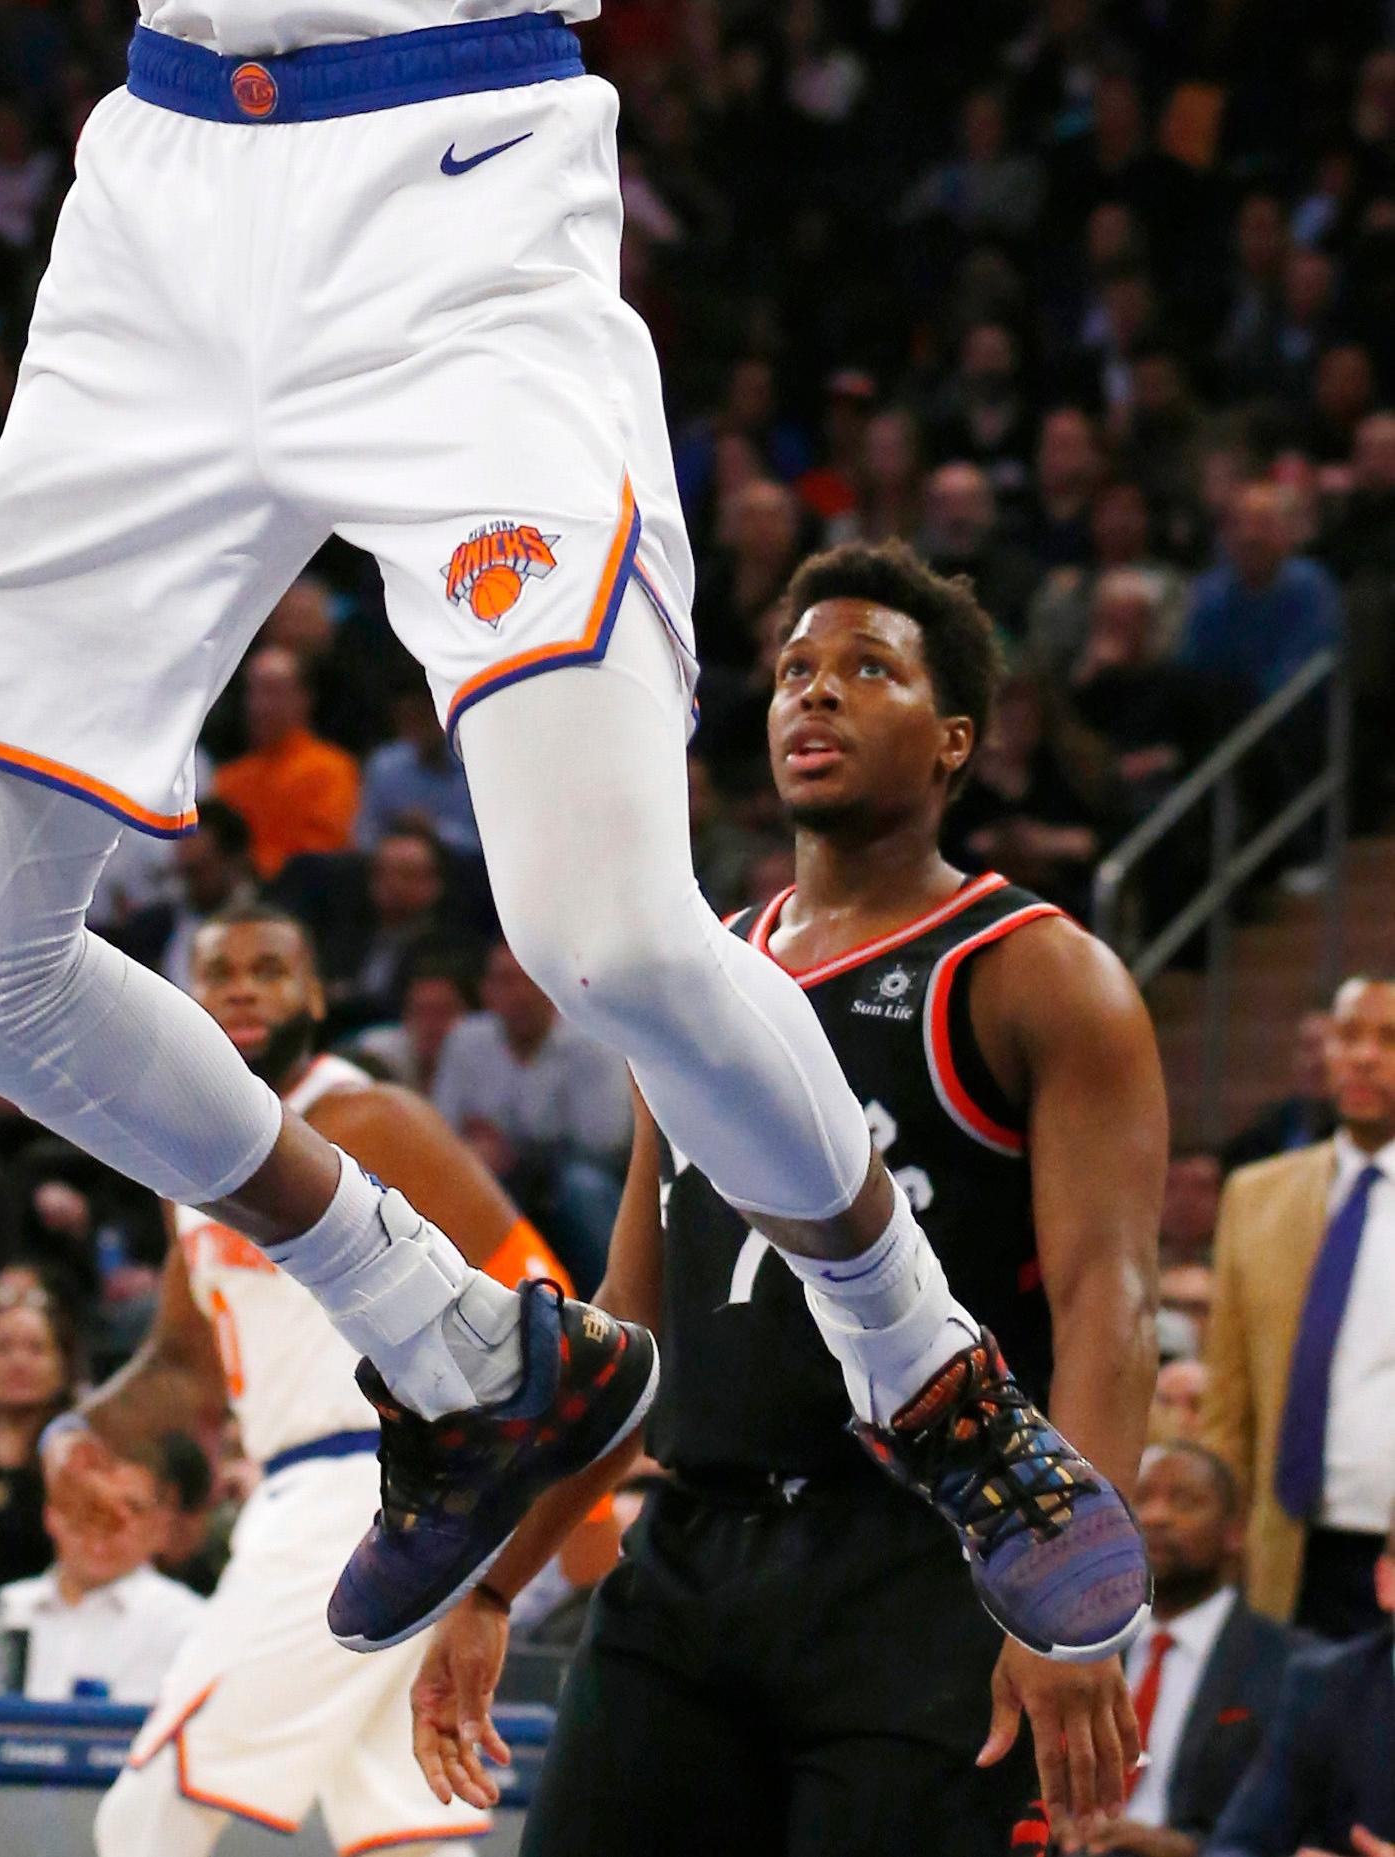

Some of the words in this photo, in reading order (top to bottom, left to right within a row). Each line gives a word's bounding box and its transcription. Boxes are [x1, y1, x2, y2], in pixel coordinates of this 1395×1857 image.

[446, 525, 557, 602] KNICKS
[850, 999, 883, 1016] Sun
[884, 1004, 914, 1020] Life
